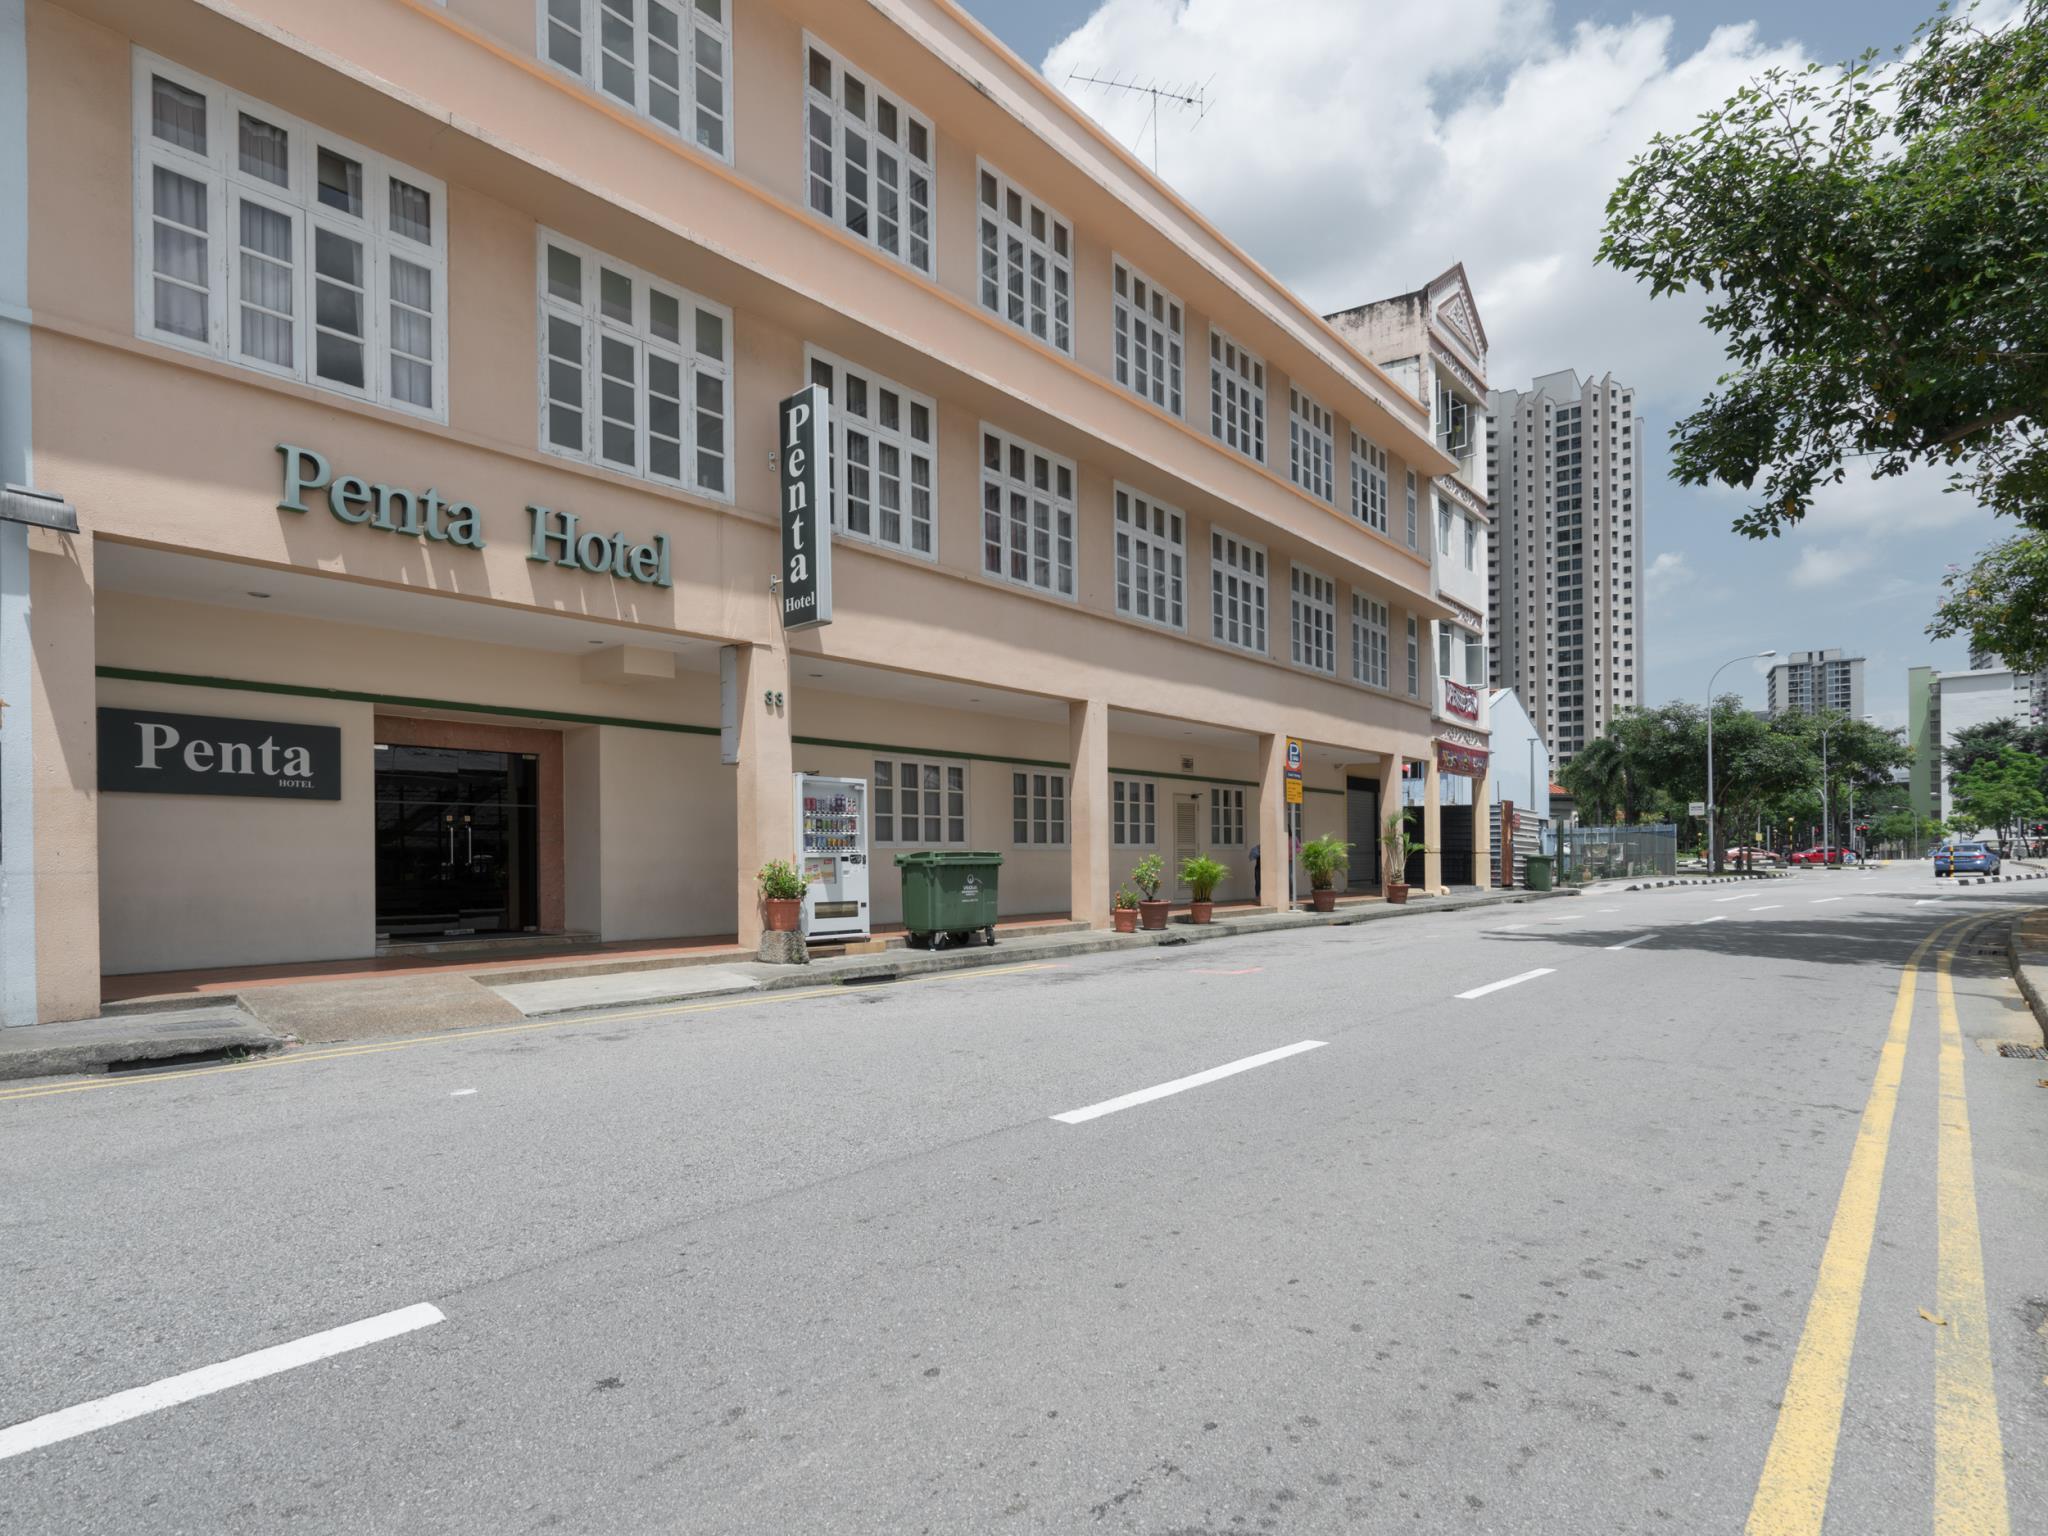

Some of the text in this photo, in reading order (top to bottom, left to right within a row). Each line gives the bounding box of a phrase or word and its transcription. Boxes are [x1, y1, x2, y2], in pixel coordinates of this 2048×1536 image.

[785, 403, 810, 584] Penta
[275, 442, 672, 588] Penta Hotel
[785, 591, 815, 612] Hotel
[133, 722, 314, 777] Penta
[1290, 744, 1299, 761] P
[279, 779, 315, 788] HOTEL
